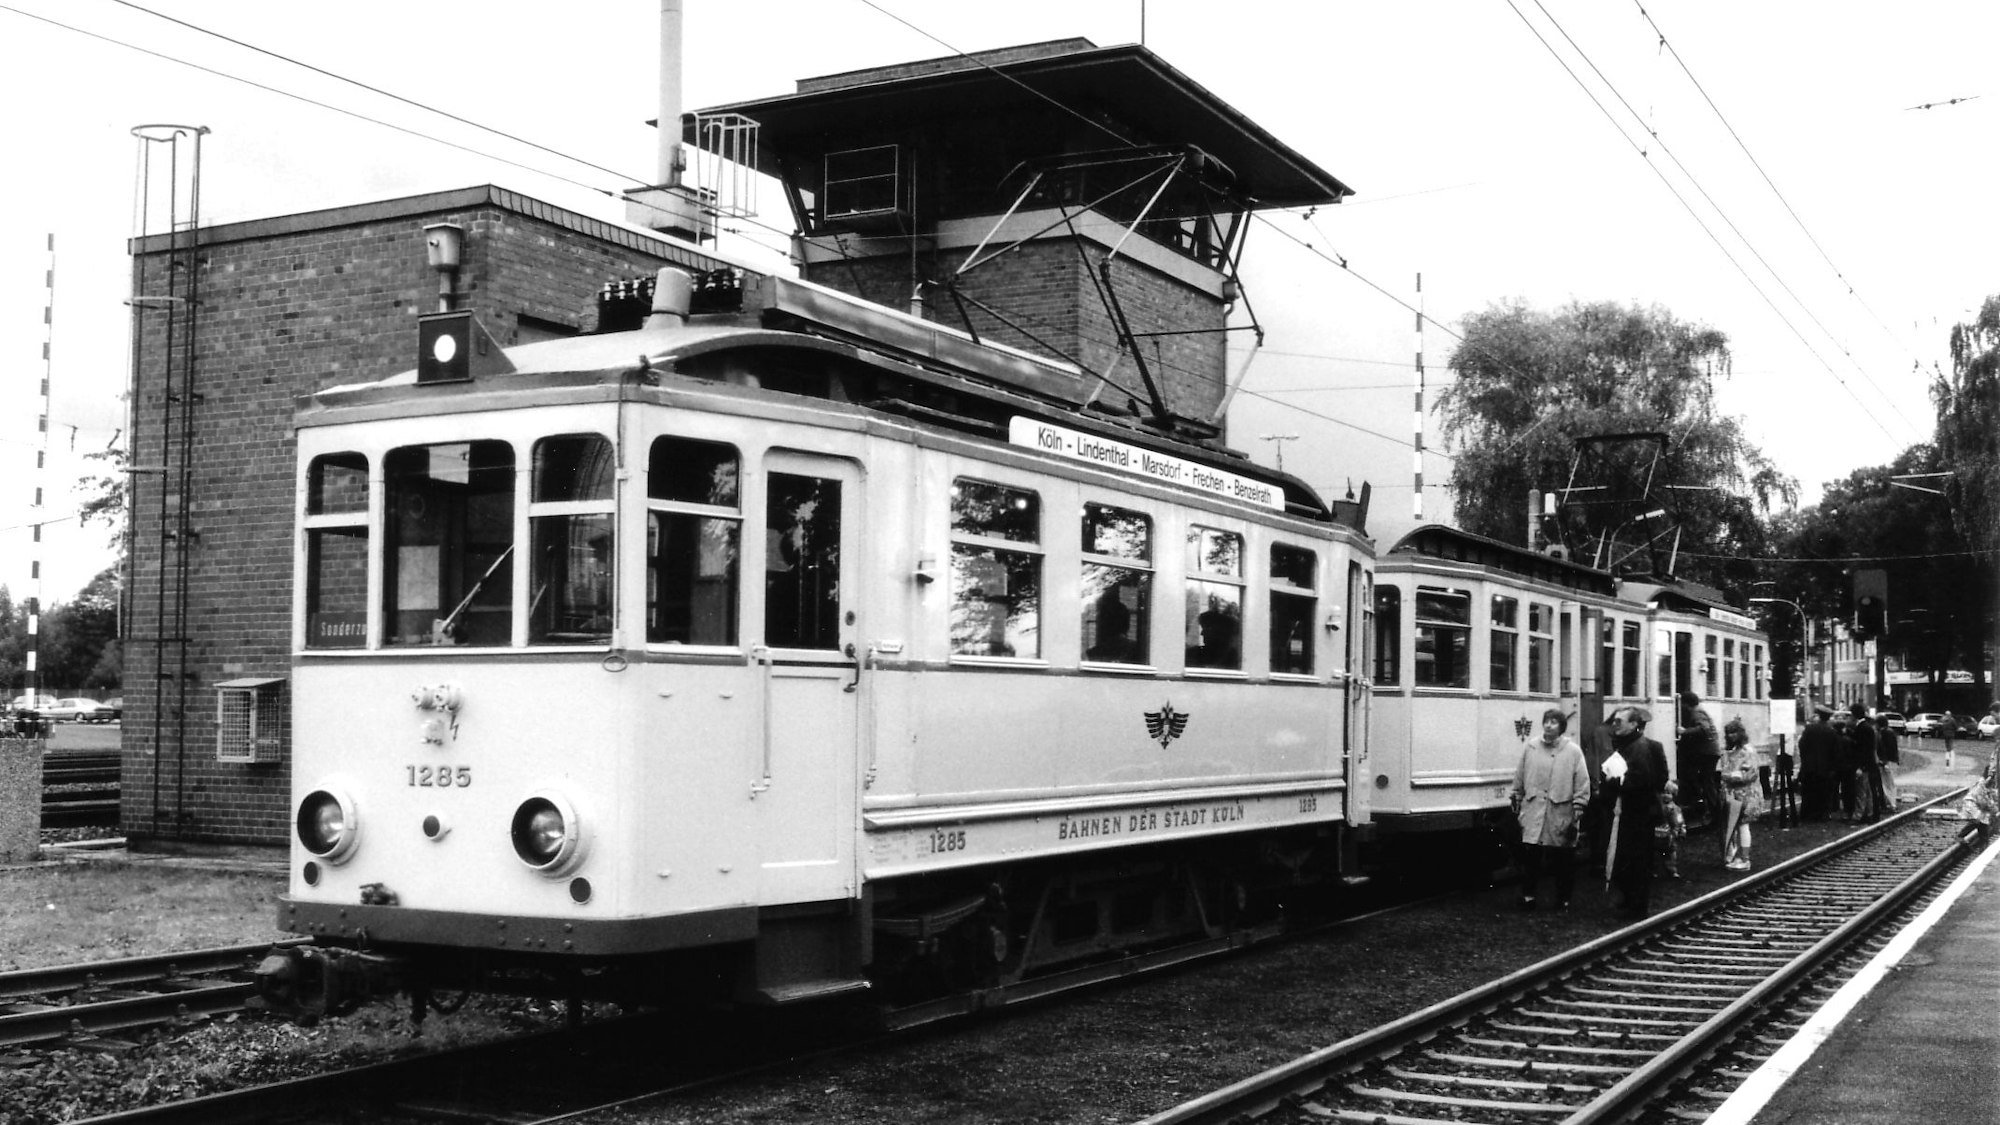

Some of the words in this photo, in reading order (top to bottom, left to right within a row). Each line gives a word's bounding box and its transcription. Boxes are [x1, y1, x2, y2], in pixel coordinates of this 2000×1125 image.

[1038, 427, 1063, 451] Köln
[1077, 435, 1130, 467] Lindenthal
[1142, 453, 1182, 480] Marsdorf
[1193, 468, 1225, 492] Frechen
[1234, 479, 1273, 505] Benzelrath
[406, 764, 472, 788] 1285
[1299, 798, 1317, 813] 1285
[1058, 816, 1121, 840] BAHNEN
[1129, 812, 1158, 832] DER
[1164, 808, 1207, 828] STADT
[929, 831, 966, 854] 1285
